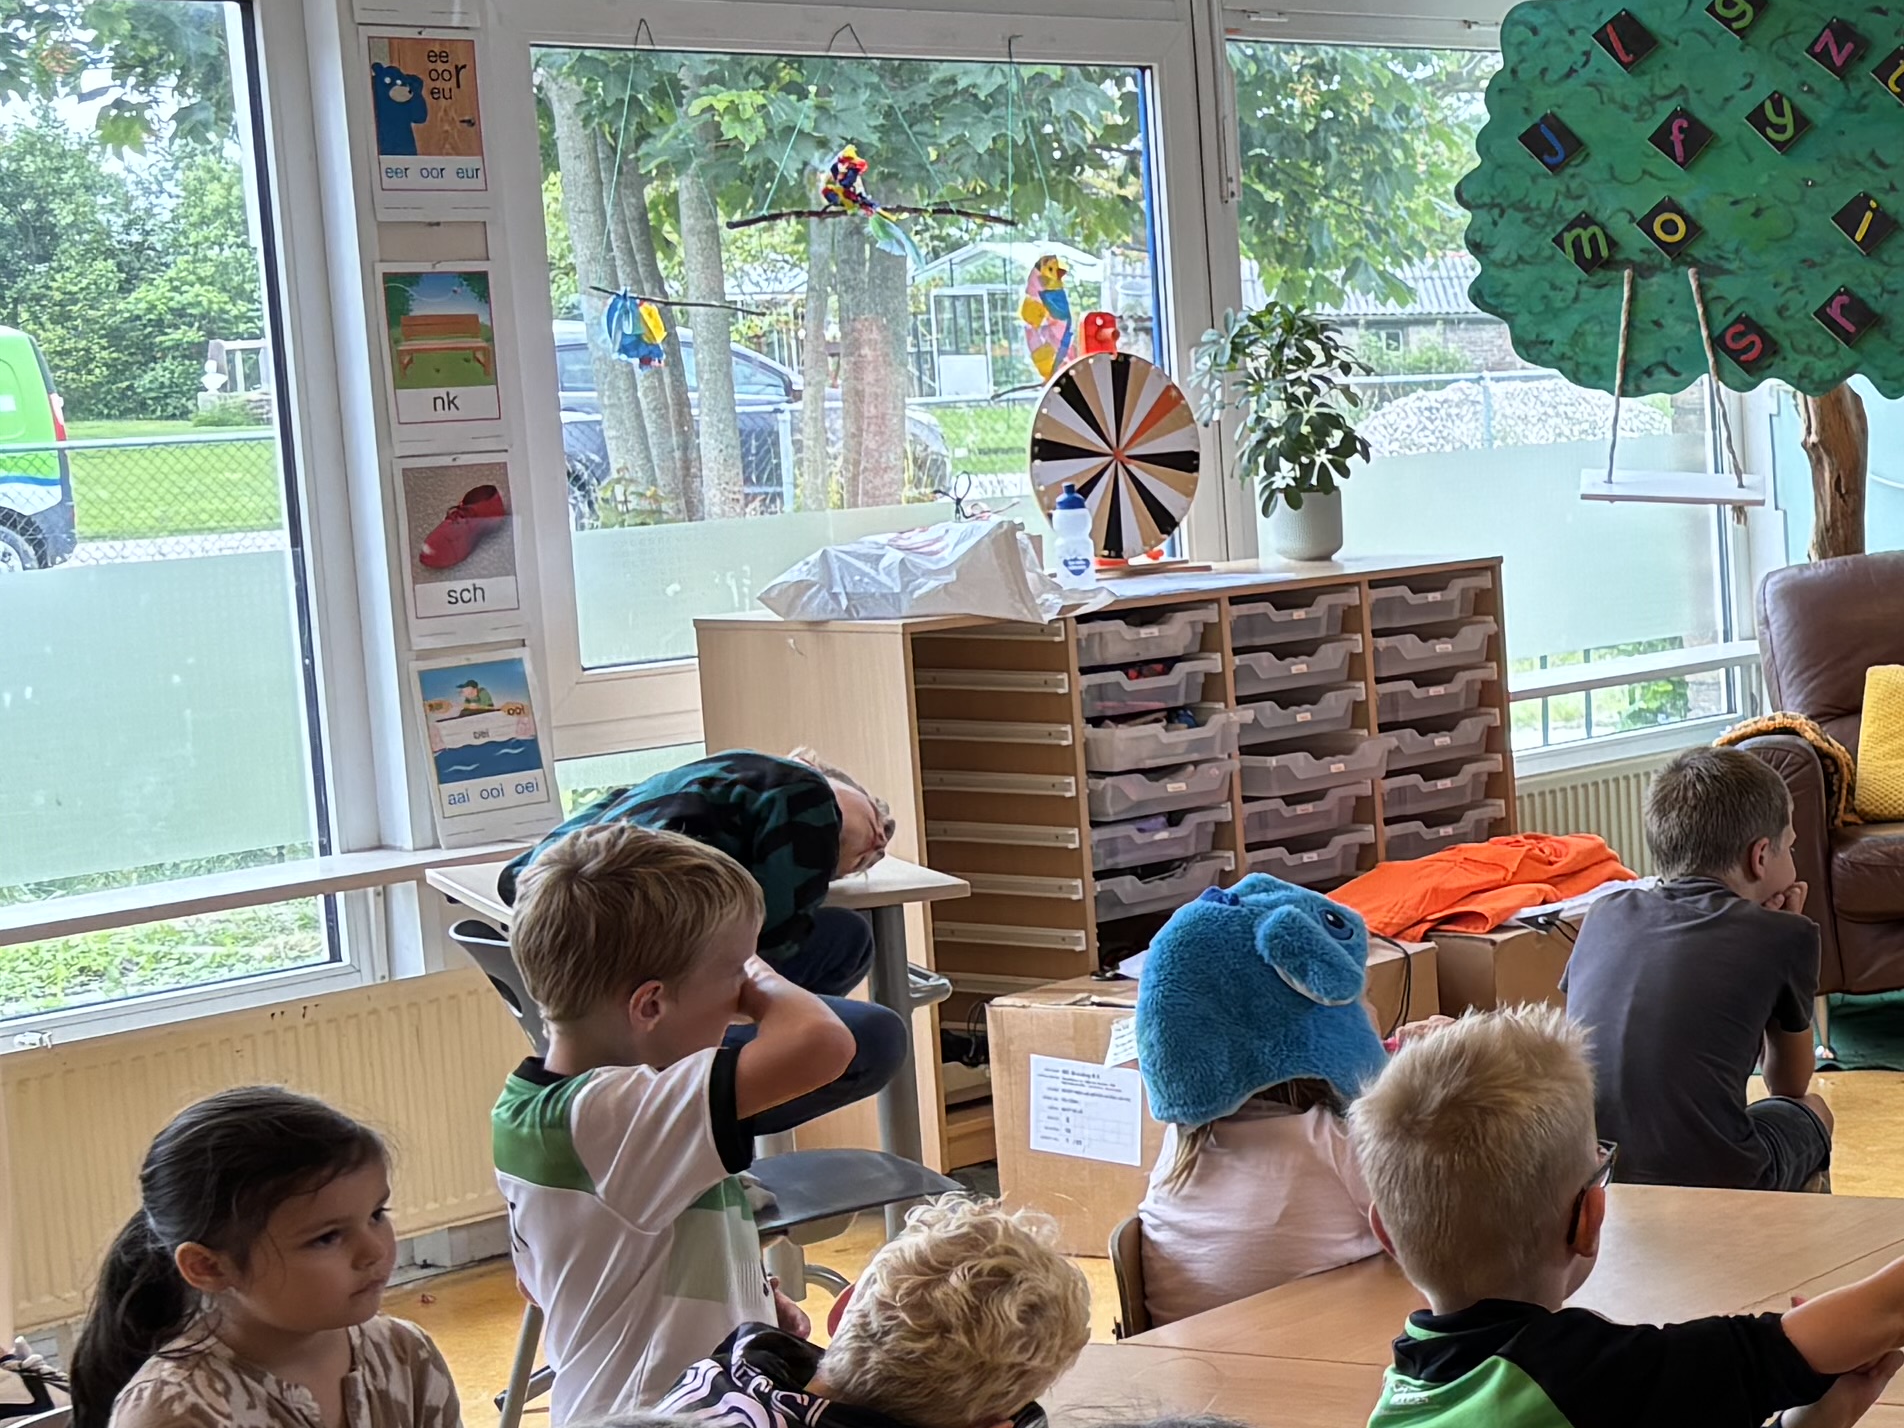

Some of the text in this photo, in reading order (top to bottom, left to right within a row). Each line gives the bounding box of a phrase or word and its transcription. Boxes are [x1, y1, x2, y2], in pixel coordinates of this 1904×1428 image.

[427, 49, 450, 64] ee
[428, 68, 453, 82] oo
[455, 63, 467, 89] r
[430, 86, 453, 101] eu
[1764, 96, 1795, 143] y
[1669, 118, 1688, 162] f
[385, 166, 480, 180] eer oor eur
[1854, 198, 1878, 242] i
[1563, 225, 1610, 263] m
[1826, 294, 1857, 334] r
[433, 390, 460, 412] nk
[446, 582, 486, 606] sch
[448, 776, 540, 806] aai ooi oei
